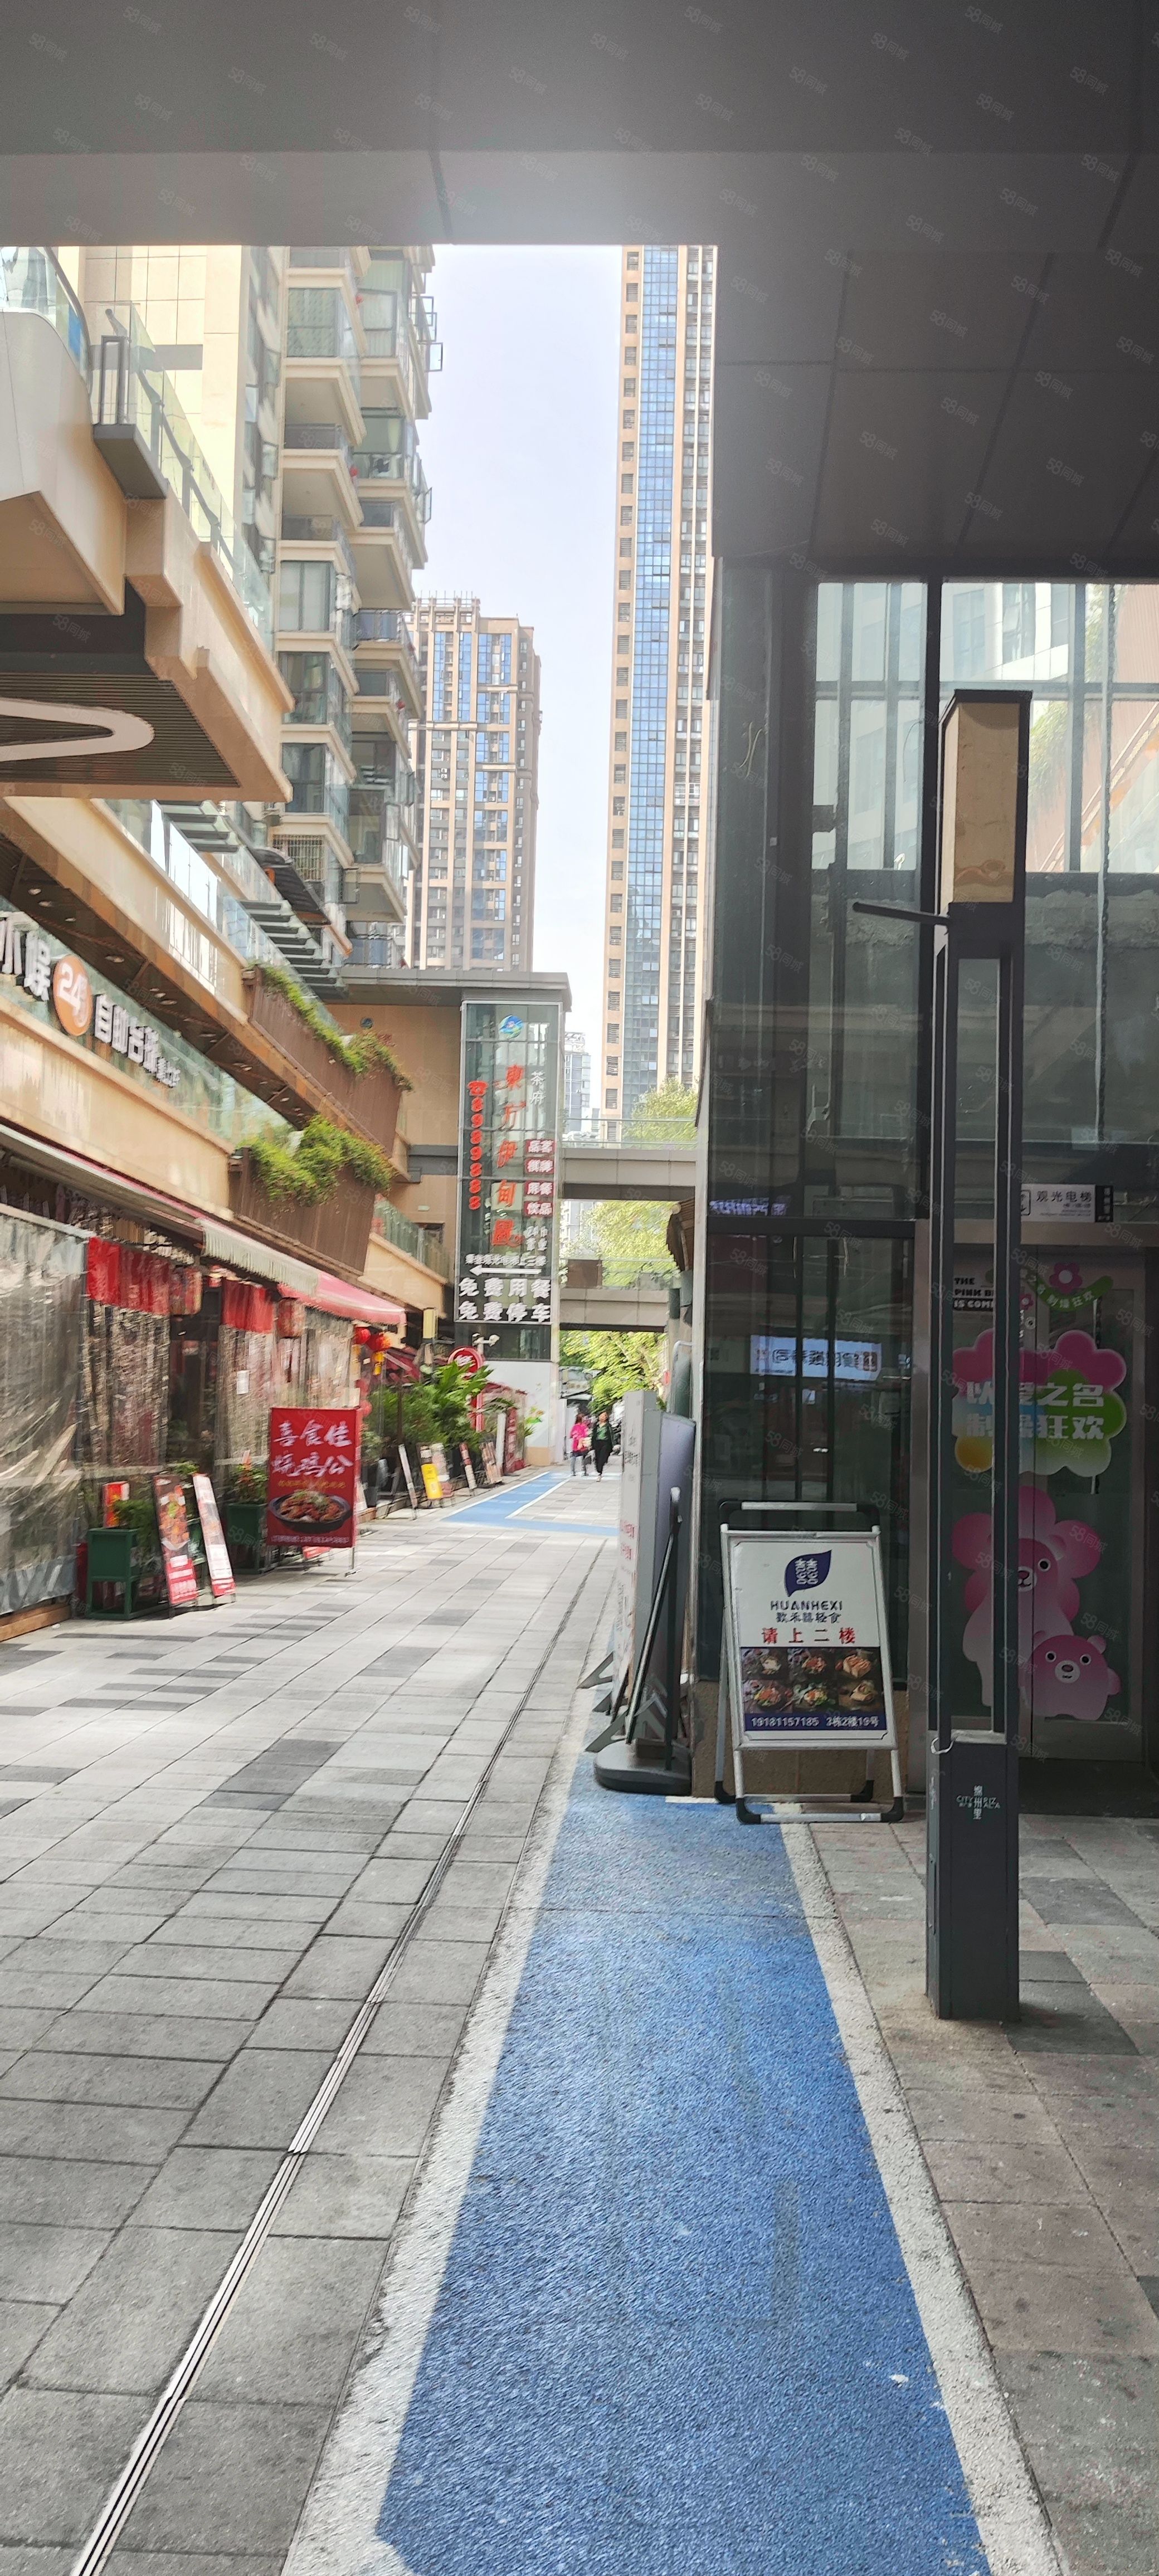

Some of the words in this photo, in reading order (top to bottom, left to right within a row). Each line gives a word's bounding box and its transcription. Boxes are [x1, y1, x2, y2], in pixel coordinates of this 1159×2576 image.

[530, 1070, 547, 1105] 茶府
[1036, 1191, 1092, 1203] 观光电梯
[459, 1277, 551, 1299] 免费用餐
[459, 1301, 551, 1323] 免费停车
[770, 1601, 843, 1611] HUANHEXI
[761, 1627, 856, 1645] 请上二楼
